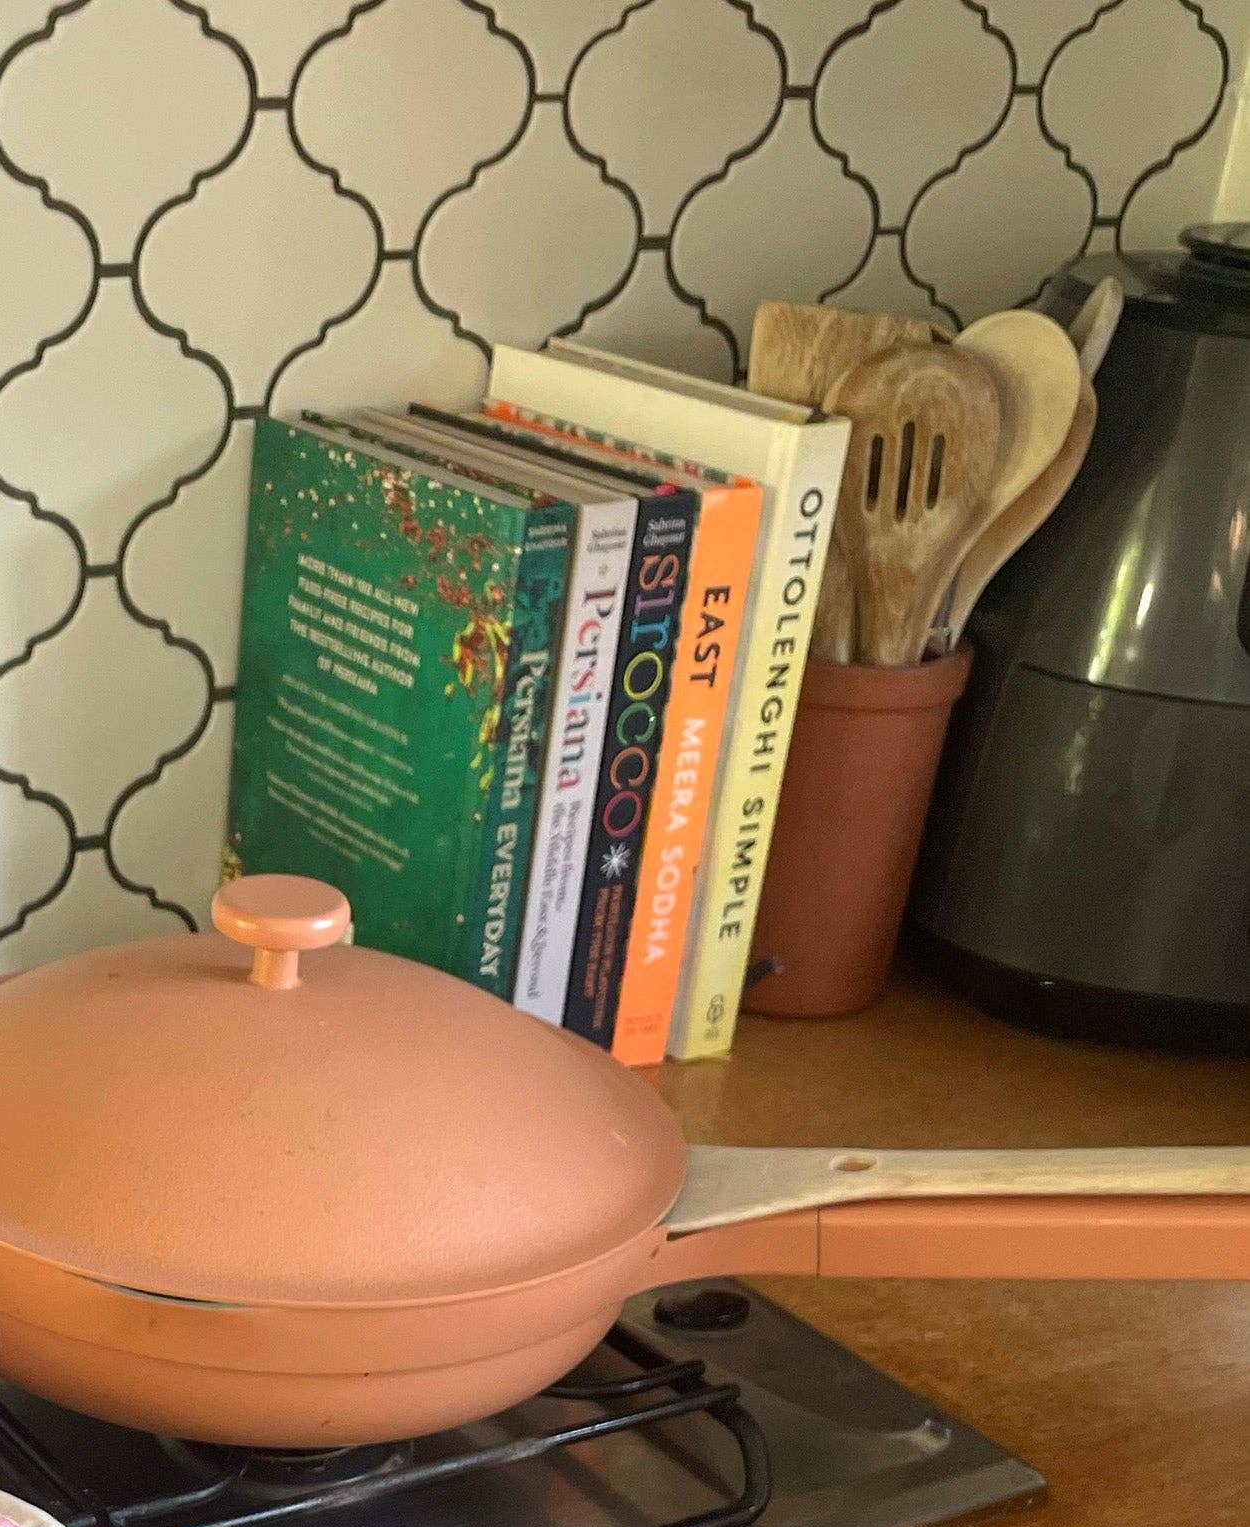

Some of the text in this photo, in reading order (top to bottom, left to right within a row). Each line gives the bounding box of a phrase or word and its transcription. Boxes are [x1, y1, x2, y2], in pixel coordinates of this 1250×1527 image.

[557, 587, 616, 791] Persiana
[689, 585, 731, 688] EAST
[718, 486, 823, 941] OTTOLENGHI SIMPLE
[479, 650, 549, 977] Persiana EVERYDAY
[664, 717, 706, 833] MEERA
[640, 844, 684, 966] SODHA
